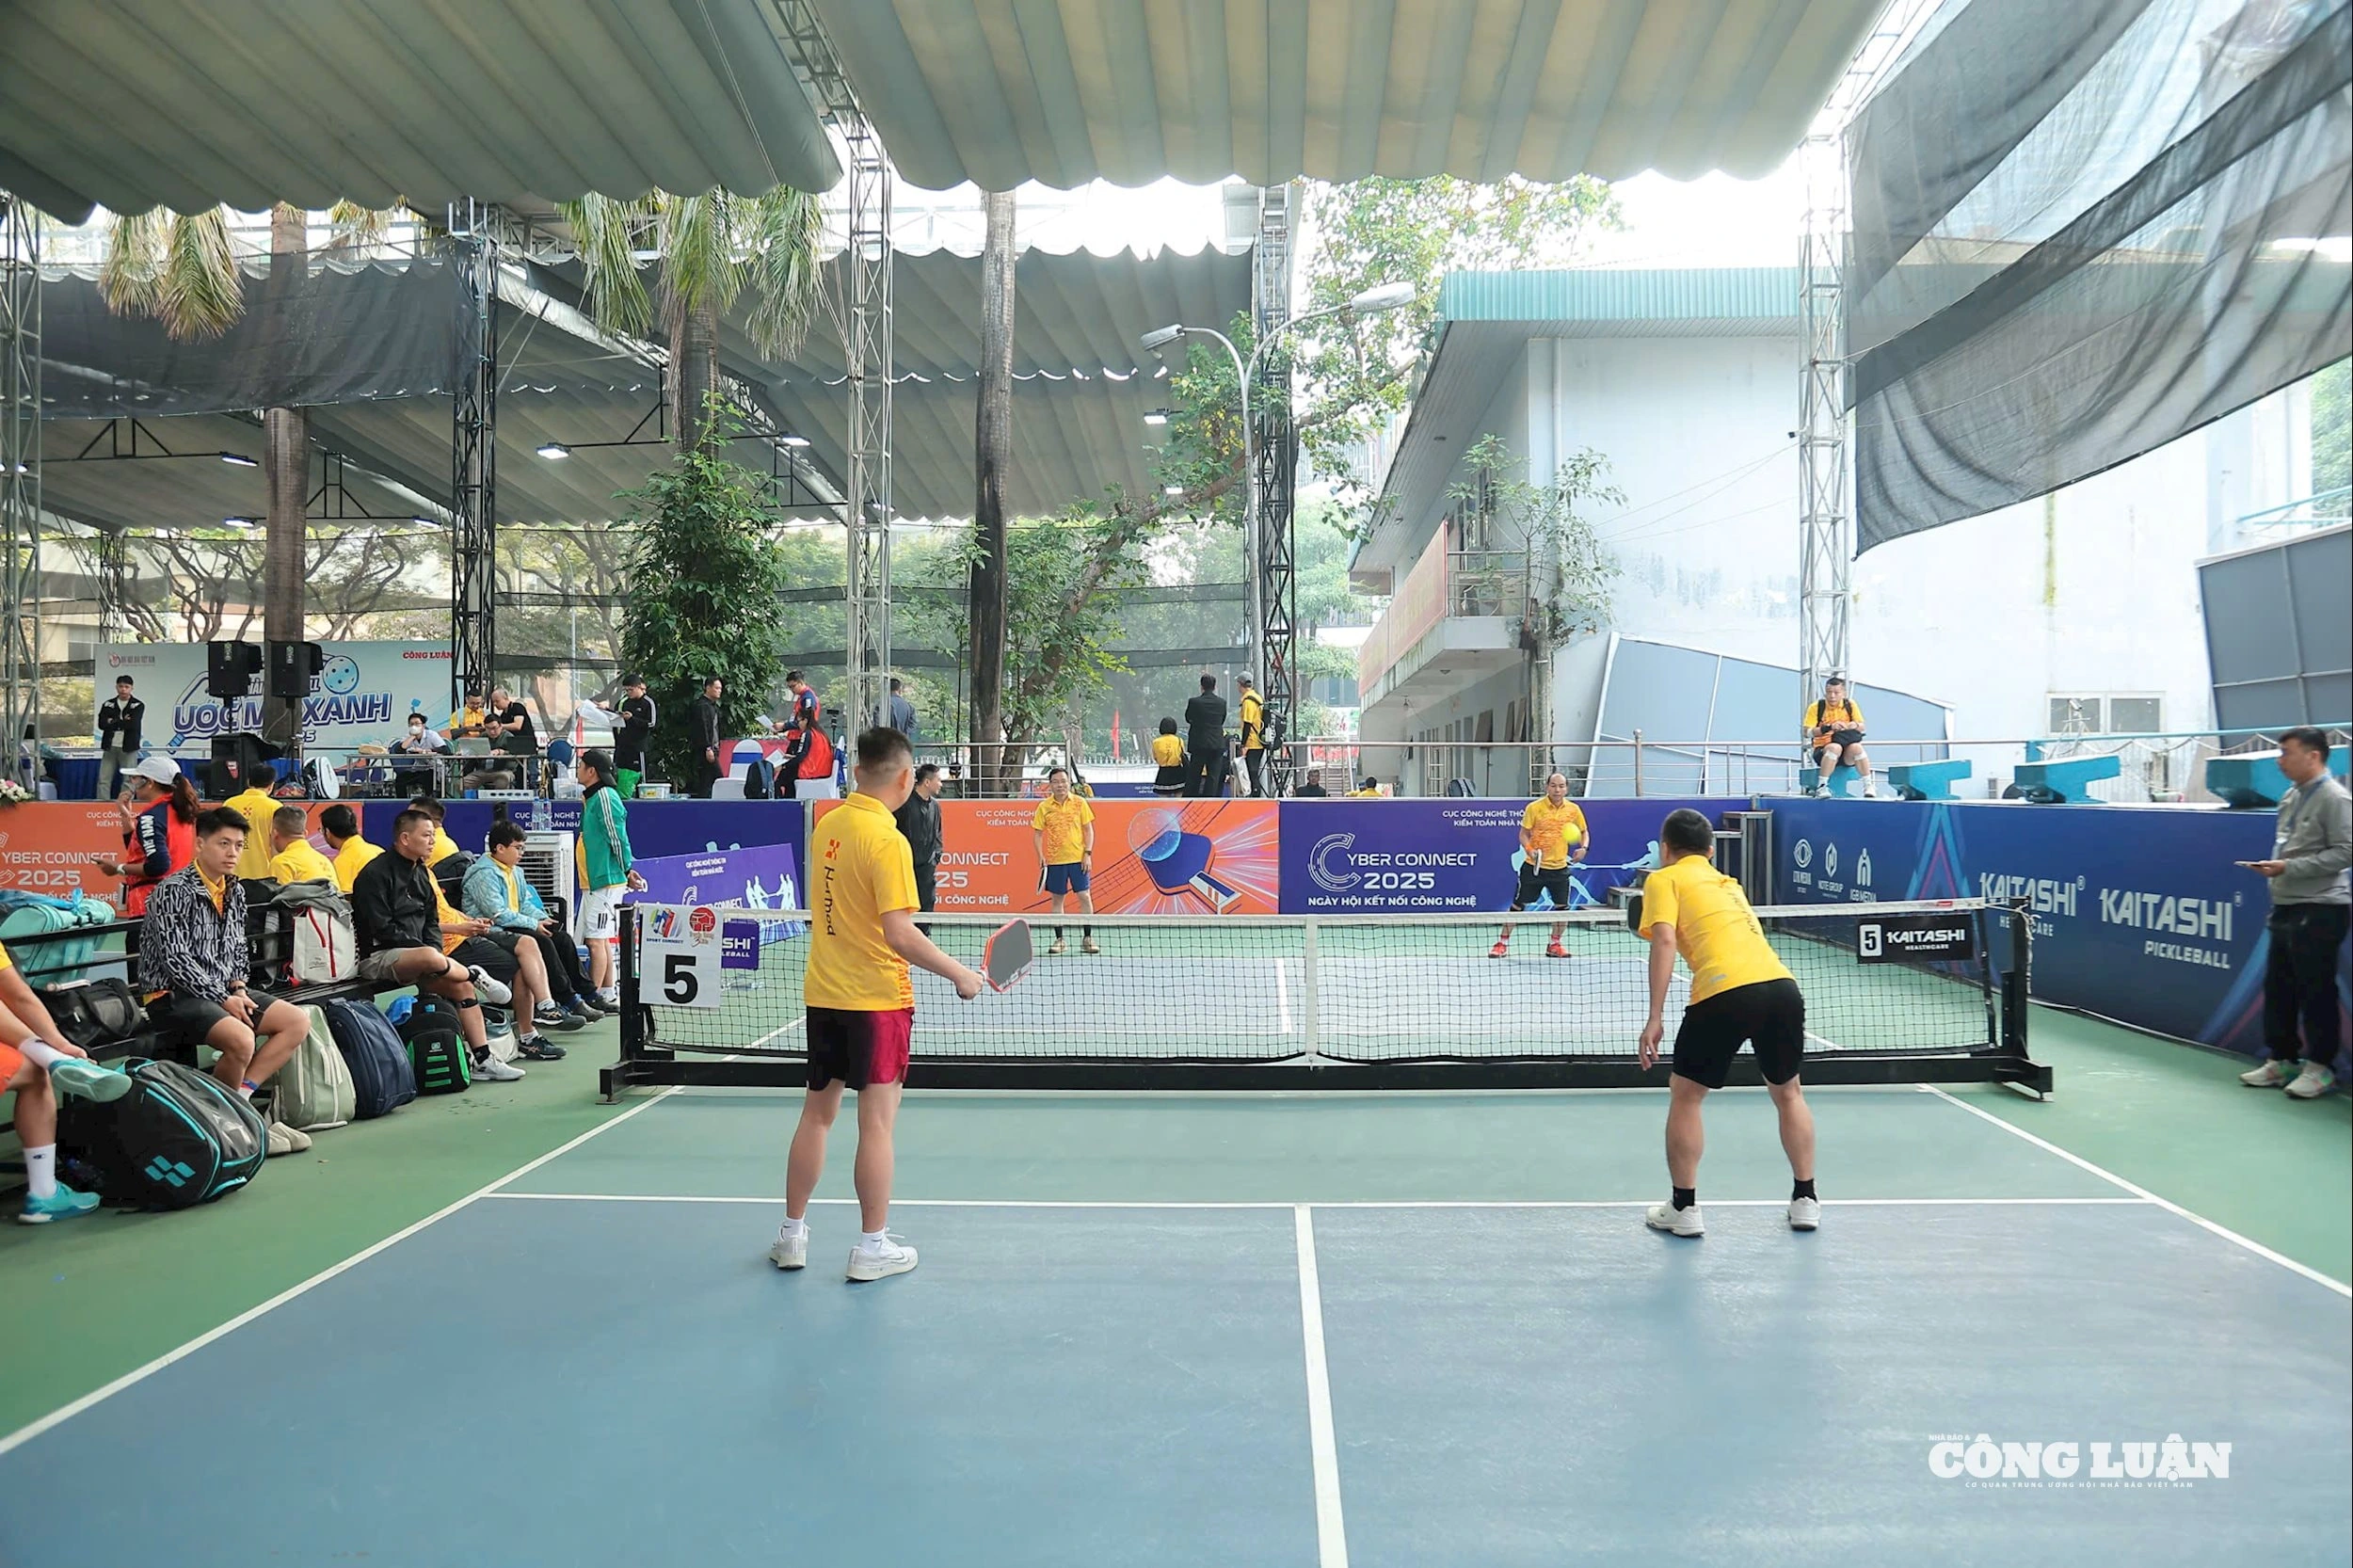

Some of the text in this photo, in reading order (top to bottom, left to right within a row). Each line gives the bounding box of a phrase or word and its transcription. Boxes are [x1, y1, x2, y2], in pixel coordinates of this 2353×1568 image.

[301, 693, 392, 727] XANH
[1484, 809, 1507, 818] NGHỆ
[141, 815, 154, 838] NAM
[1453, 818, 1473, 826] KIỂM
[940, 853, 1009, 865] ONNECT
[1395, 853, 1477, 866] CONNECT
[18, 870, 81, 886] 2025
[933, 872, 968, 888] 25
[1364, 872, 1435, 889] 2025
[945, 894, 976, 904] CÔNG
[979, 894, 1010, 905] NGHỆ
[1308, 894, 1477, 907] NGÀY HỘI KẾT NỐI CÔNG NGHỆ
[1999, 915, 2054, 937] HECARE
[1865, 931, 1878, 951] 5
[1886, 929, 1965, 943] KAITASHI
[2144, 940, 2231, 969] PICKLEBALL
[664, 953, 698, 1004] 5
